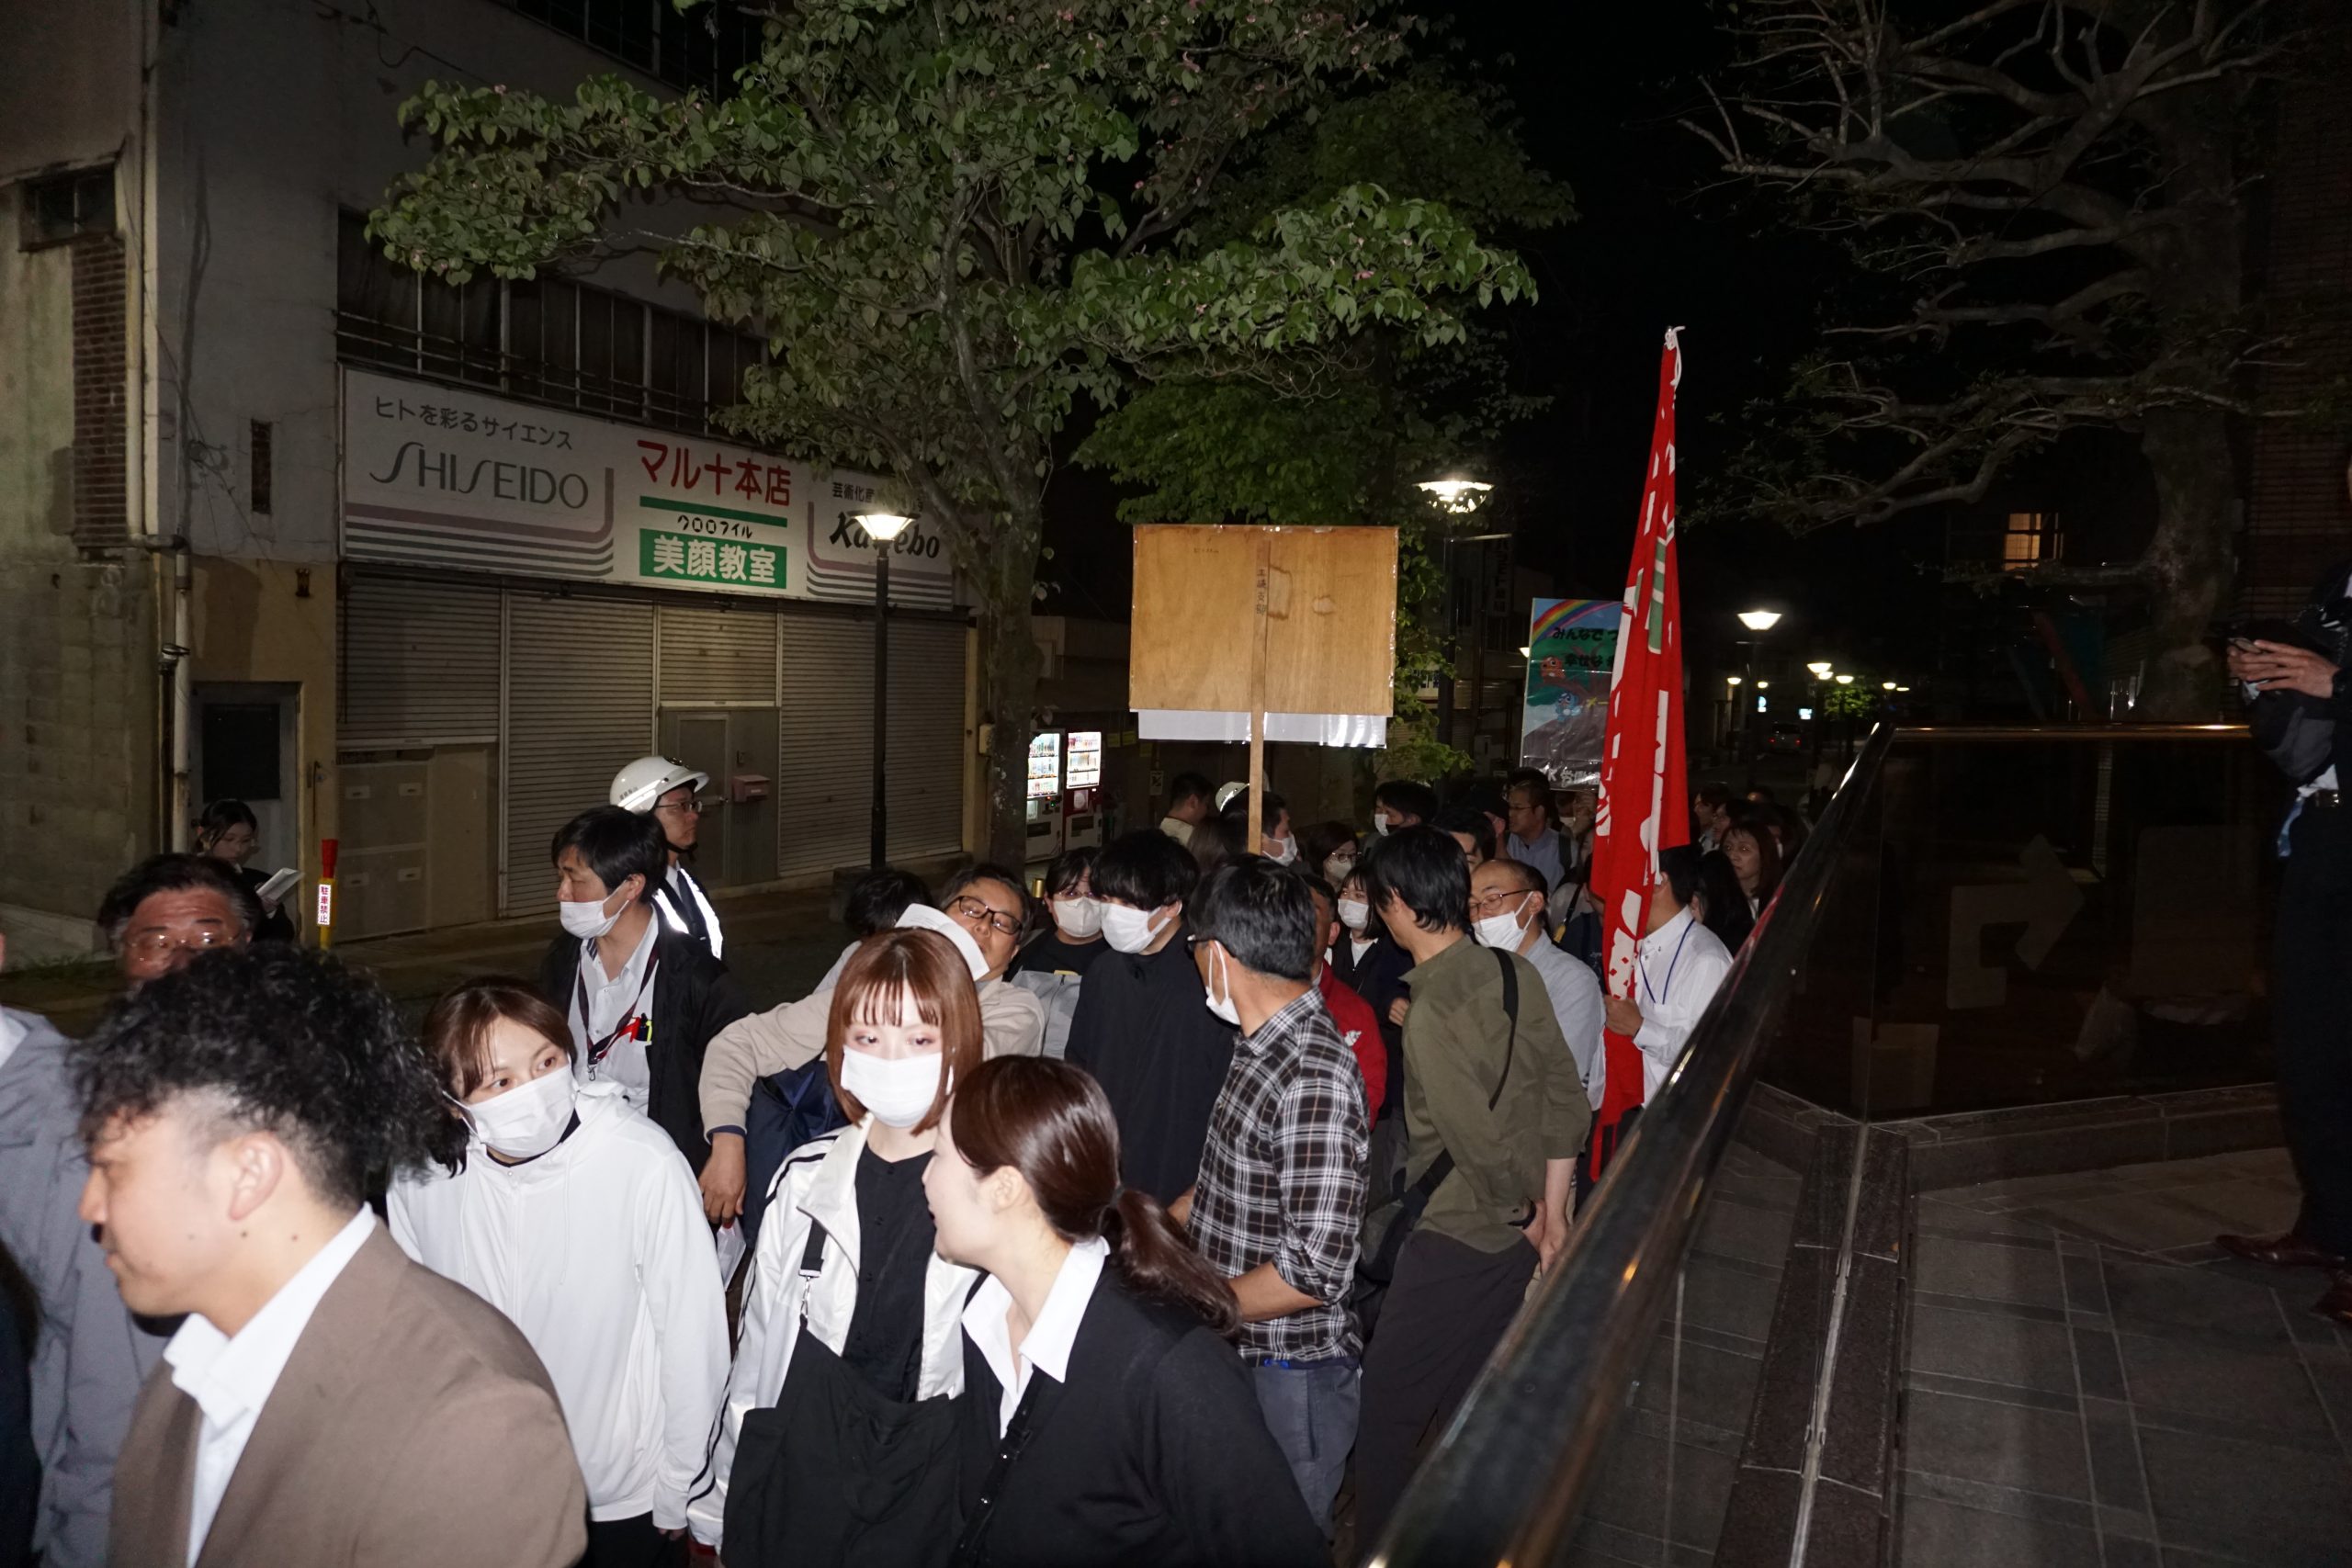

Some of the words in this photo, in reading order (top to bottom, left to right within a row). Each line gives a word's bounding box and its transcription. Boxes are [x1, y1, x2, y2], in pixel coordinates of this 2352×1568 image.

[375, 395, 573, 450] ヒトを彩るサイエンス
[369, 441, 589, 509] SHISEIDO
[637, 439, 791, 506] マル十本店
[652, 534, 776, 584] 美顔教室
[829, 511, 940, 558] Kaebo
[320, 886, 329, 923] 駐車禁止
